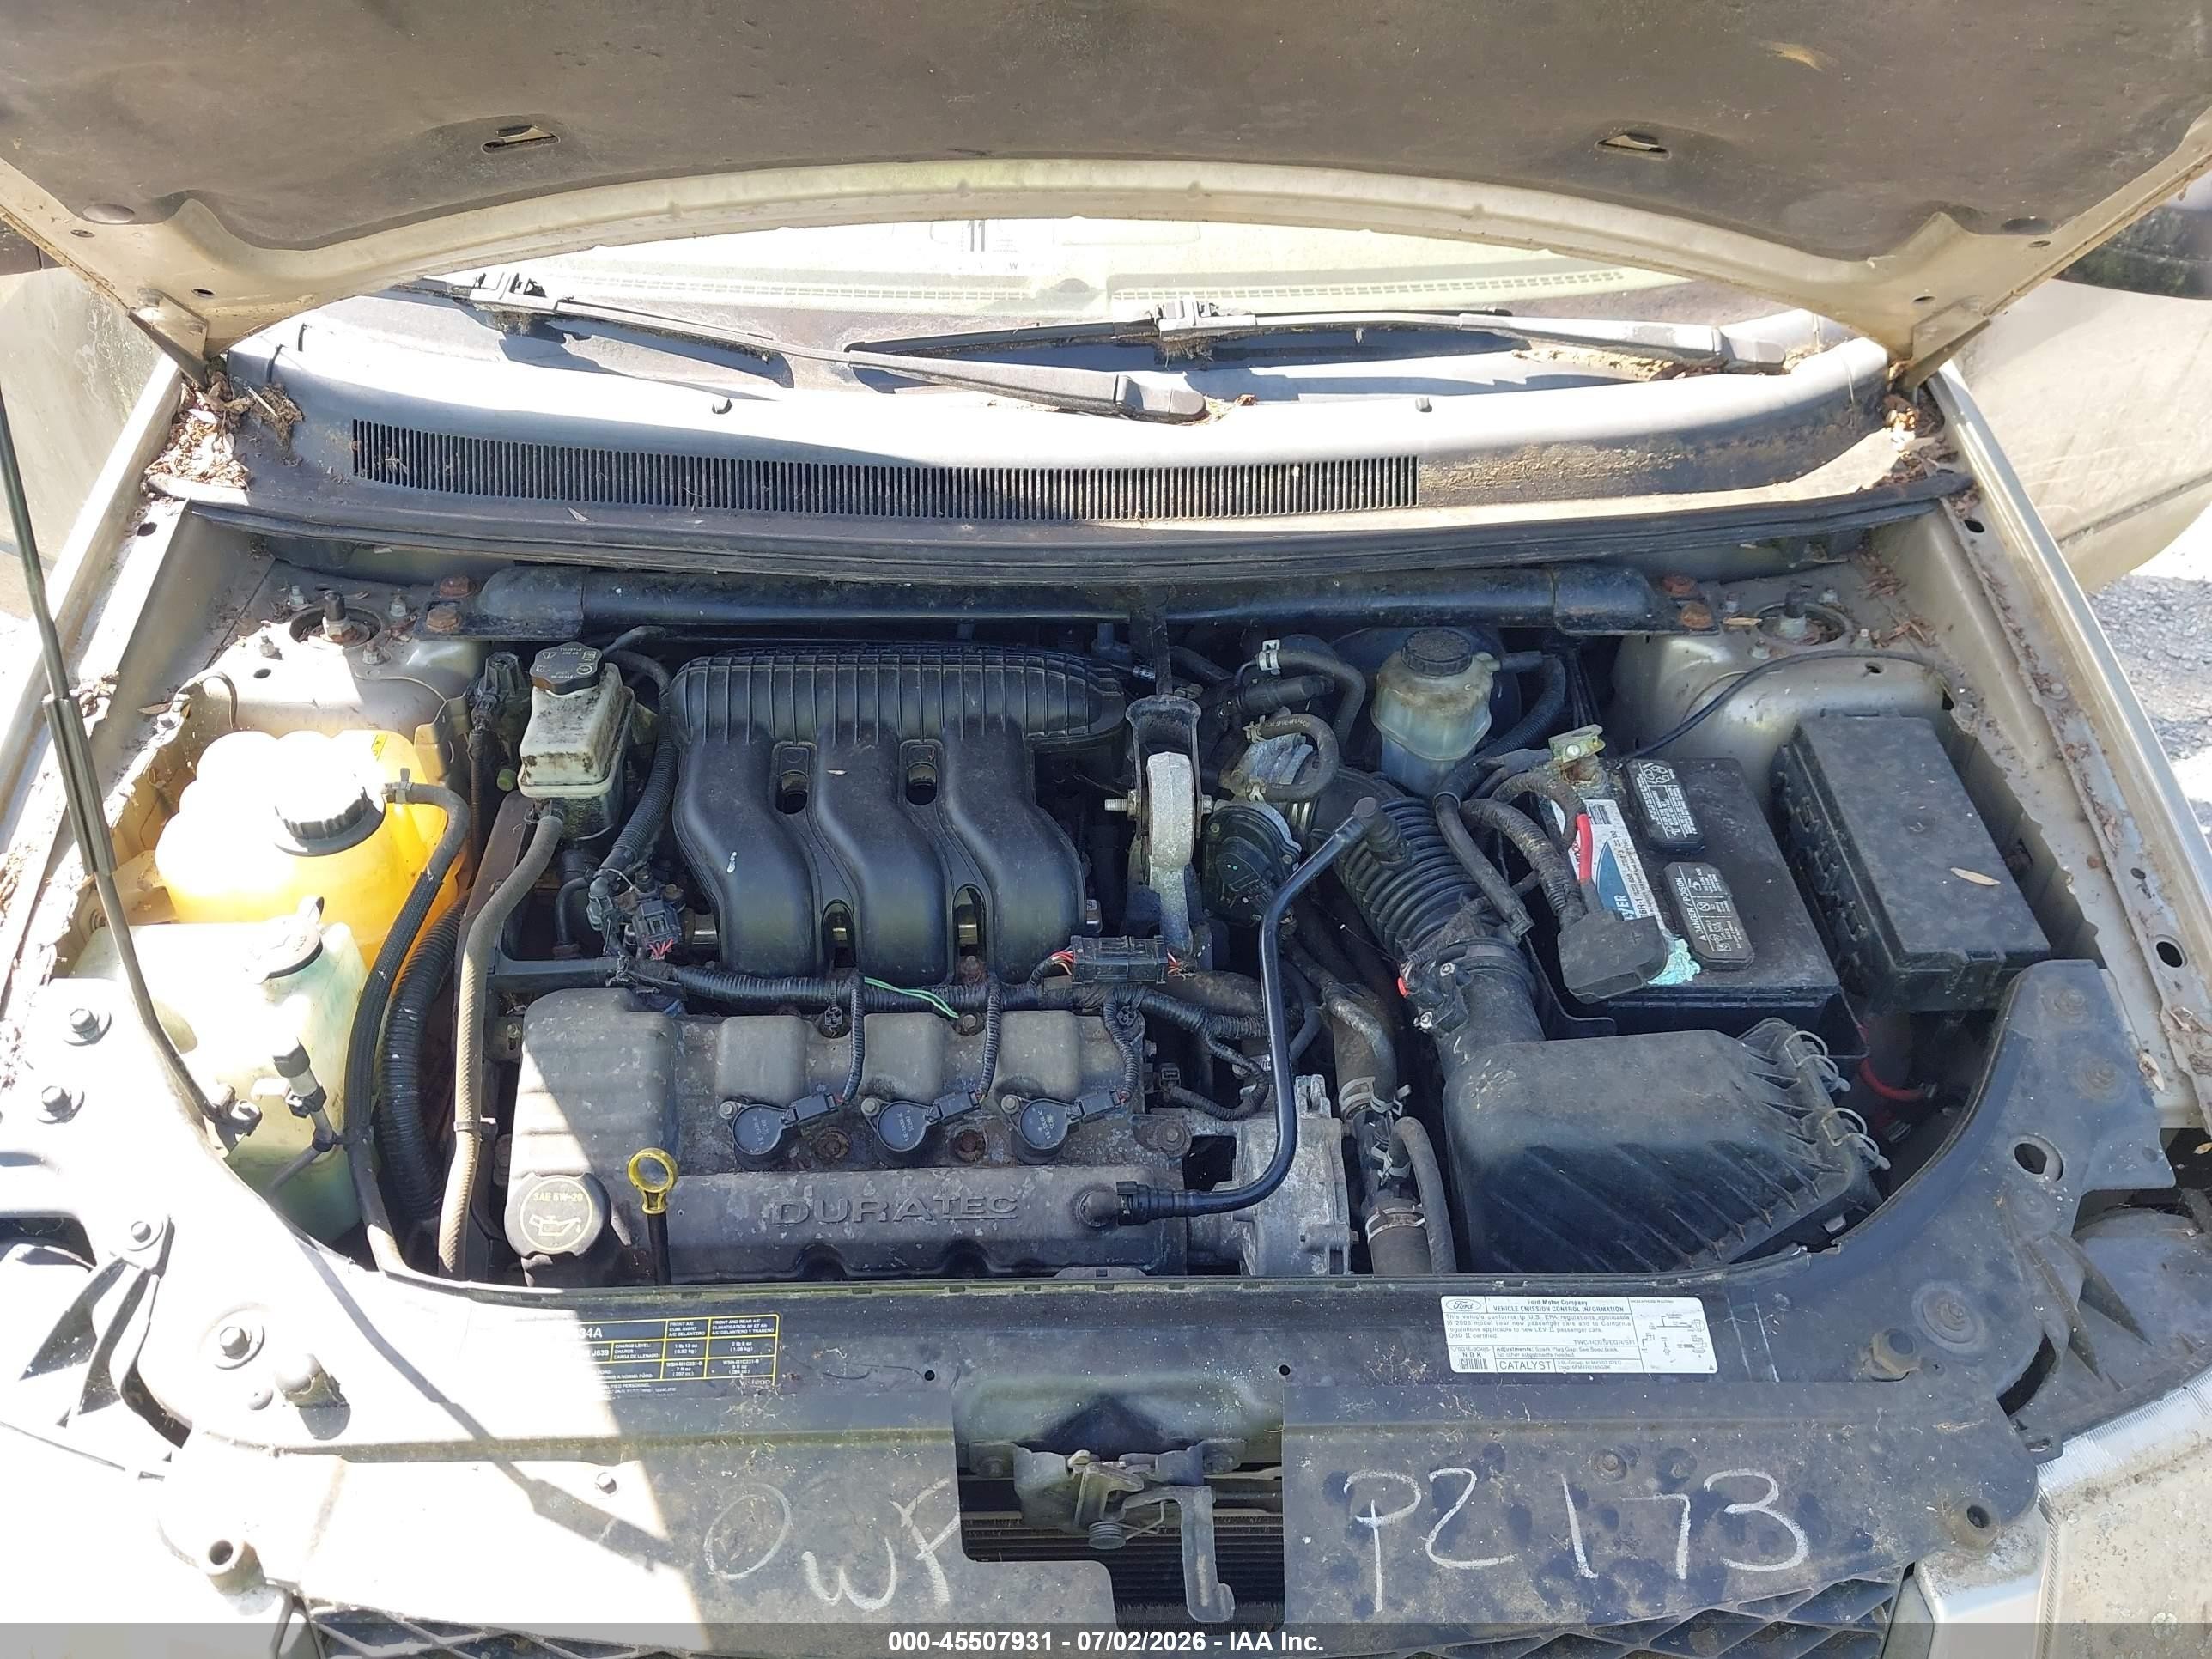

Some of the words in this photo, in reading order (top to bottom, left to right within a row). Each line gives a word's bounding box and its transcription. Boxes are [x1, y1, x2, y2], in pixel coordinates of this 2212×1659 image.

[1674, 877, 1691, 902] POISON
[1686, 908, 1704, 934] DANGER
[533, 1193, 550, 1202] SAE
[553, 1193, 584, 1202] 5W-20
[774, 1196, 1018, 1224] DURATEC
[1453, 1300, 1474, 1310] Ford
[1499, 1361, 1551, 1370] CATALYST
